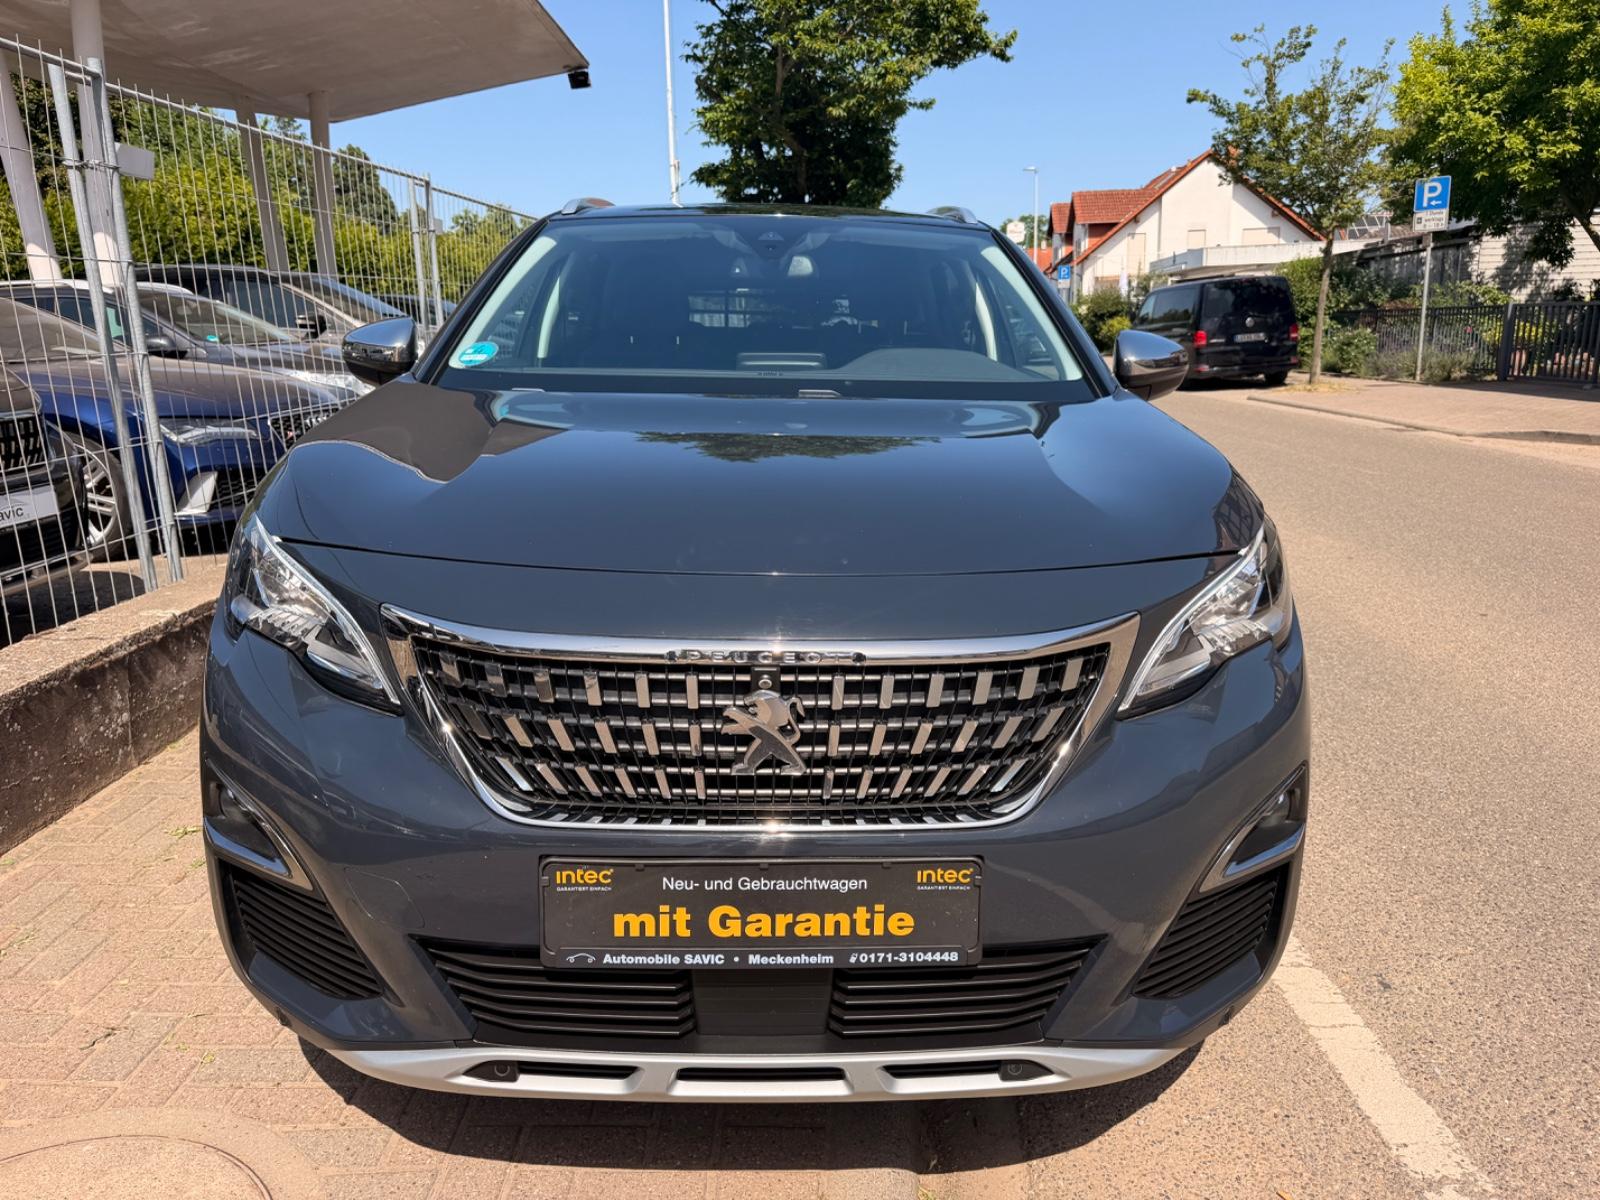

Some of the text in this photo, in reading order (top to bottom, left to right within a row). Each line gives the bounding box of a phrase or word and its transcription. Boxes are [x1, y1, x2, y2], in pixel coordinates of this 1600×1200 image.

[1423, 182, 1442, 207] P
[1061, 267, 1068, 278] P
[686, 650, 852, 664] PEUGEOT
[556, 868, 612, 884] intec
[917, 868, 971, 884] intec
[662, 877, 867, 892] Neu- und Gebrauchtwagen
[613, 904, 915, 938] mit Garantie
[603, 952, 958, 965] Automobile SAVIC Meckenheim 0171-3104448
